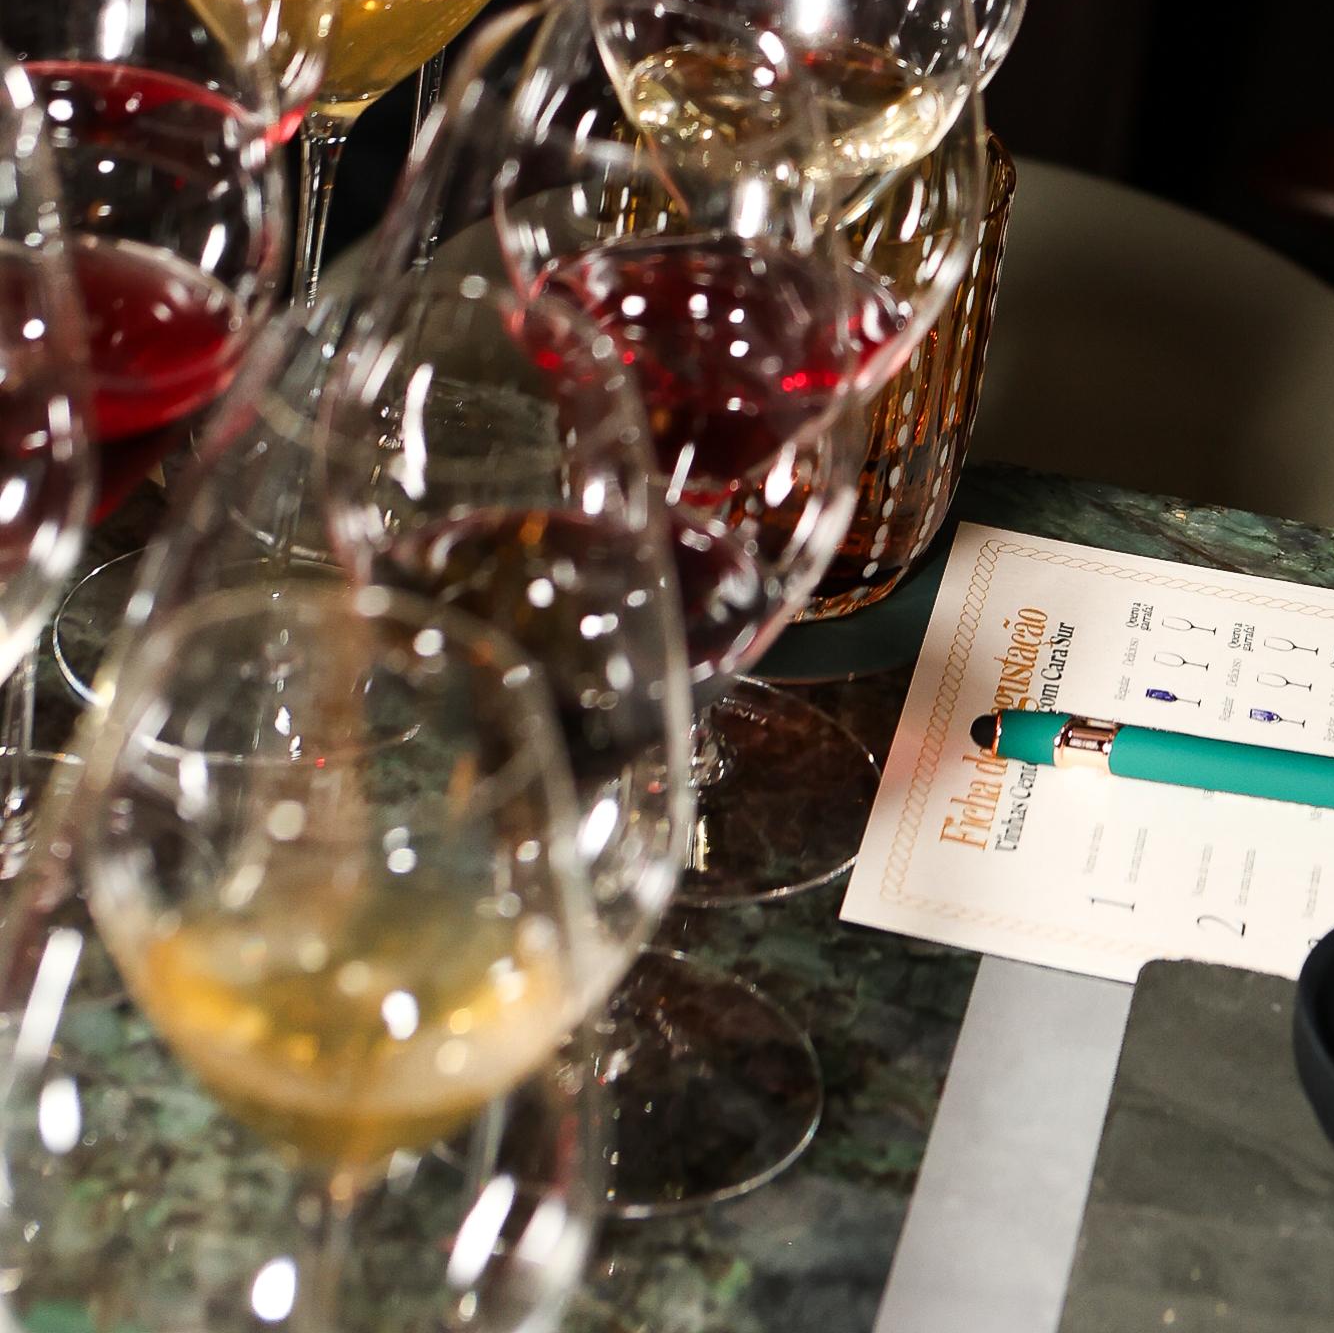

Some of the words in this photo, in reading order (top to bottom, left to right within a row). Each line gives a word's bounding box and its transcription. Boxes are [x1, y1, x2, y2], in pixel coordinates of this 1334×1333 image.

[1126, 606, 1140, 628] Quero
[1047, 621, 1075, 648] Sur
[1229, 626, 1242, 649] Quero
[1039, 648, 1068, 681] Cara
[939, 779, 1001, 848] Ficha
[991, 607, 1054, 716] gustação
[1089, 896, 1136, 912] 1
[1195, 915, 1247, 937] 2
